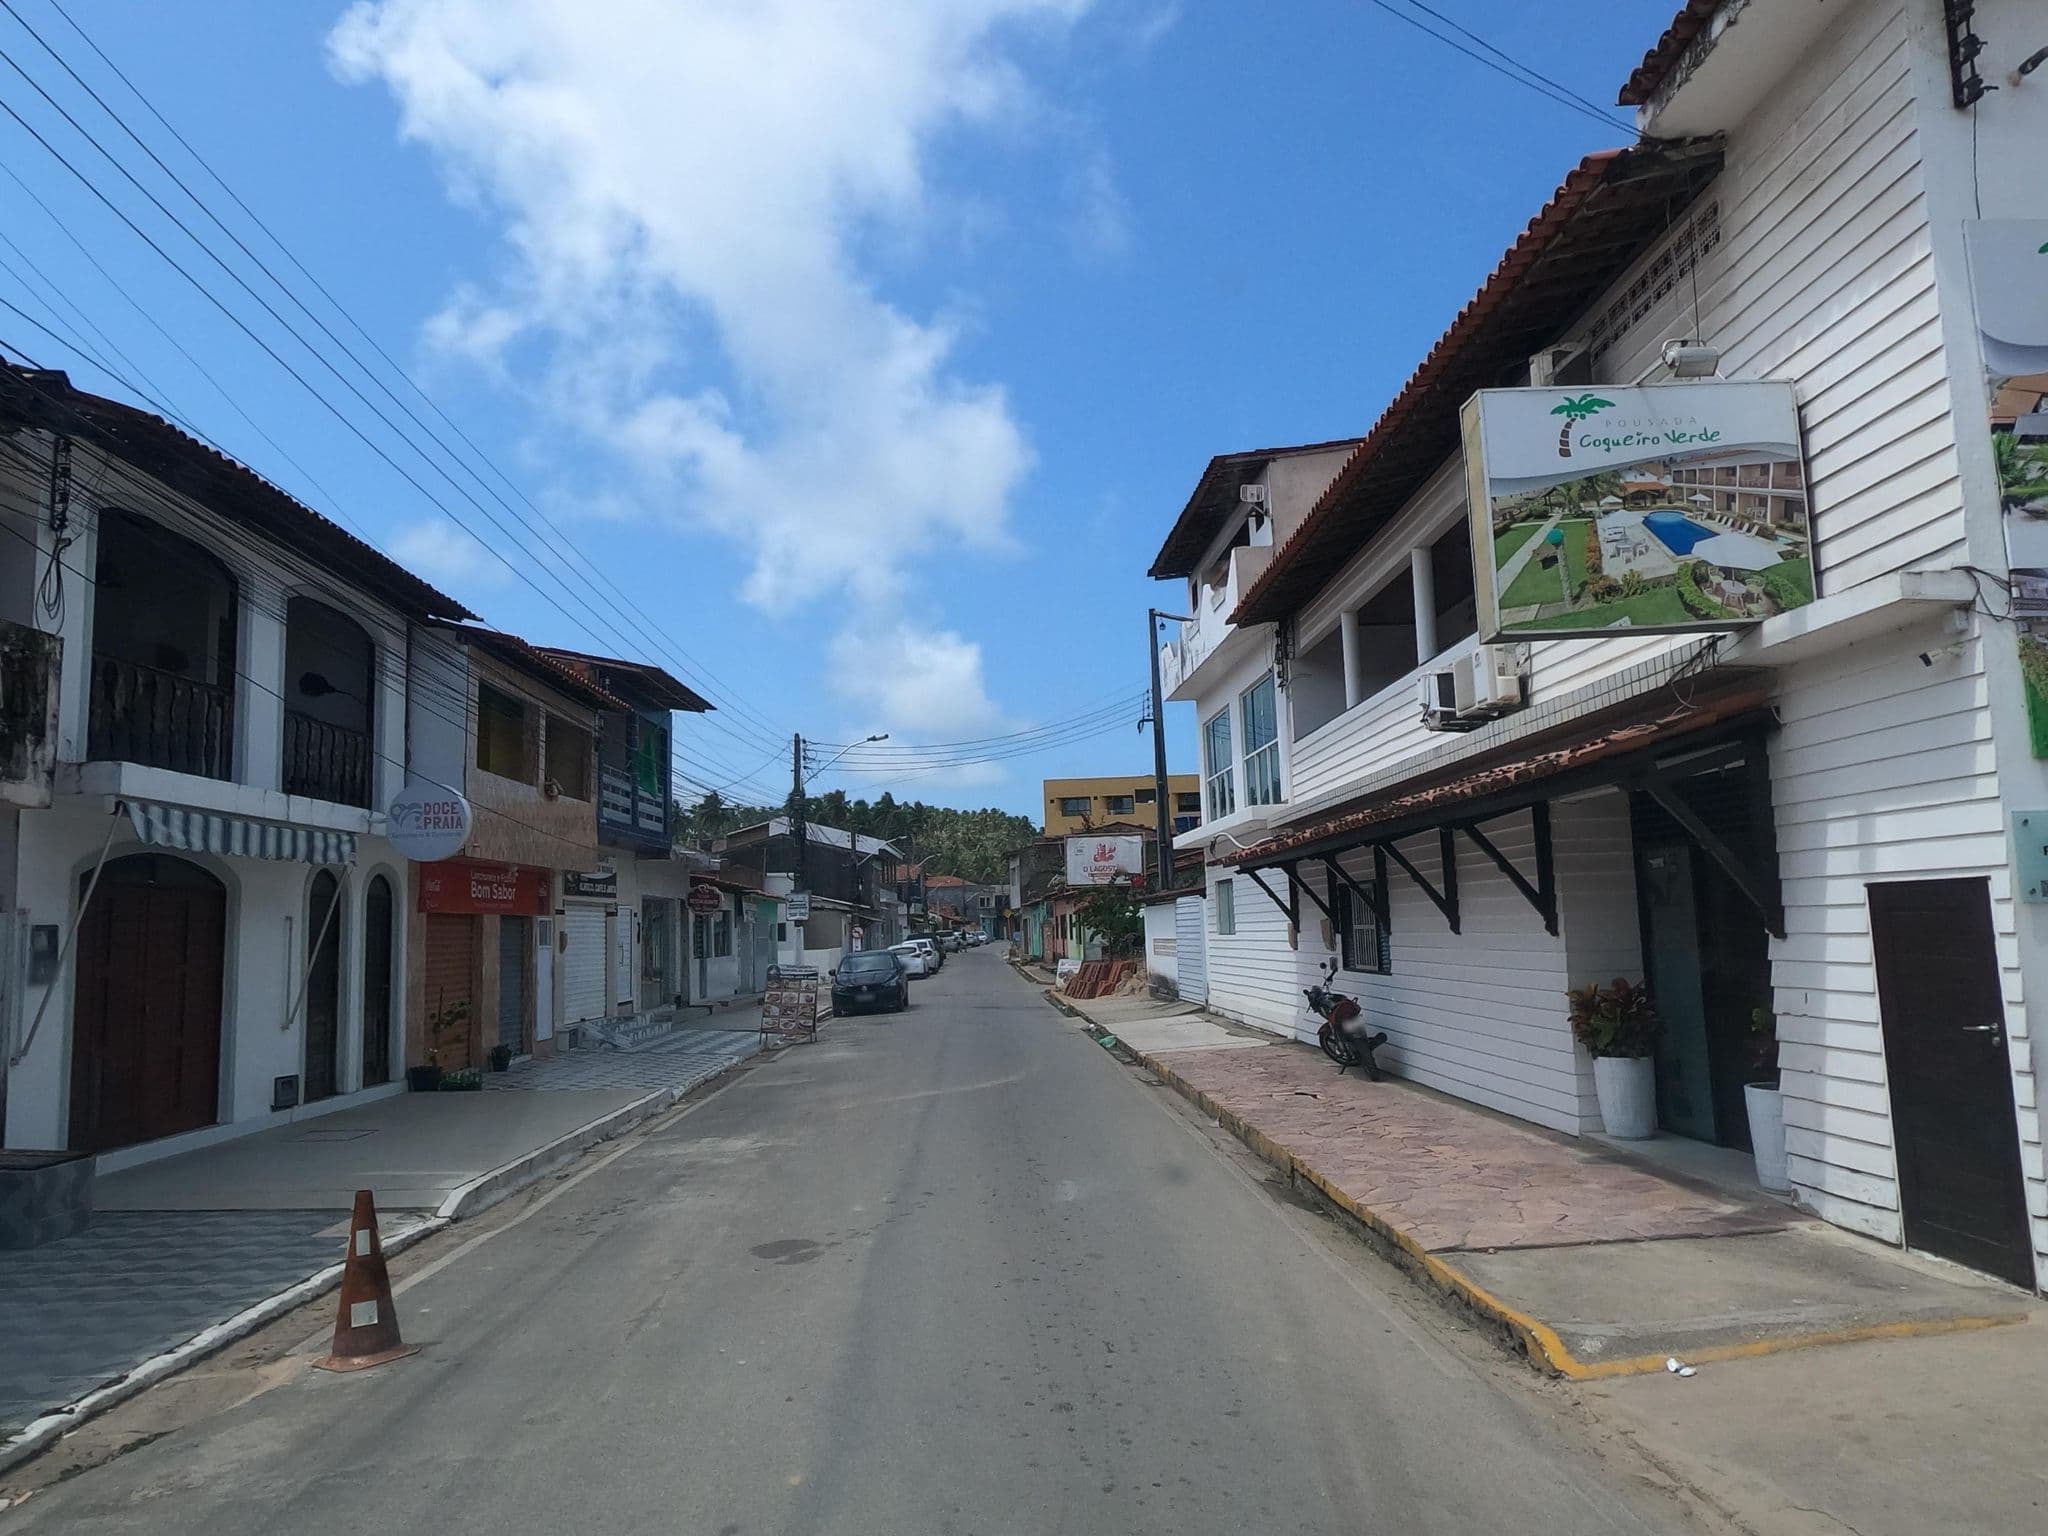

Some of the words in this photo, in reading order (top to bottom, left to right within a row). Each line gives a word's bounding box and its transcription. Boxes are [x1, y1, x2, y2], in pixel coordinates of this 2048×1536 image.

[1605, 416, 1698, 428] POUSADA
[1579, 432, 1661, 453] Coqueiro
[1664, 427, 1722, 444] Verde
[423, 801, 460, 816] DOCE
[423, 815, 464, 830] PRAIA
[470, 880, 491, 899] Bom
[492, 883, 517, 901] Sabor
